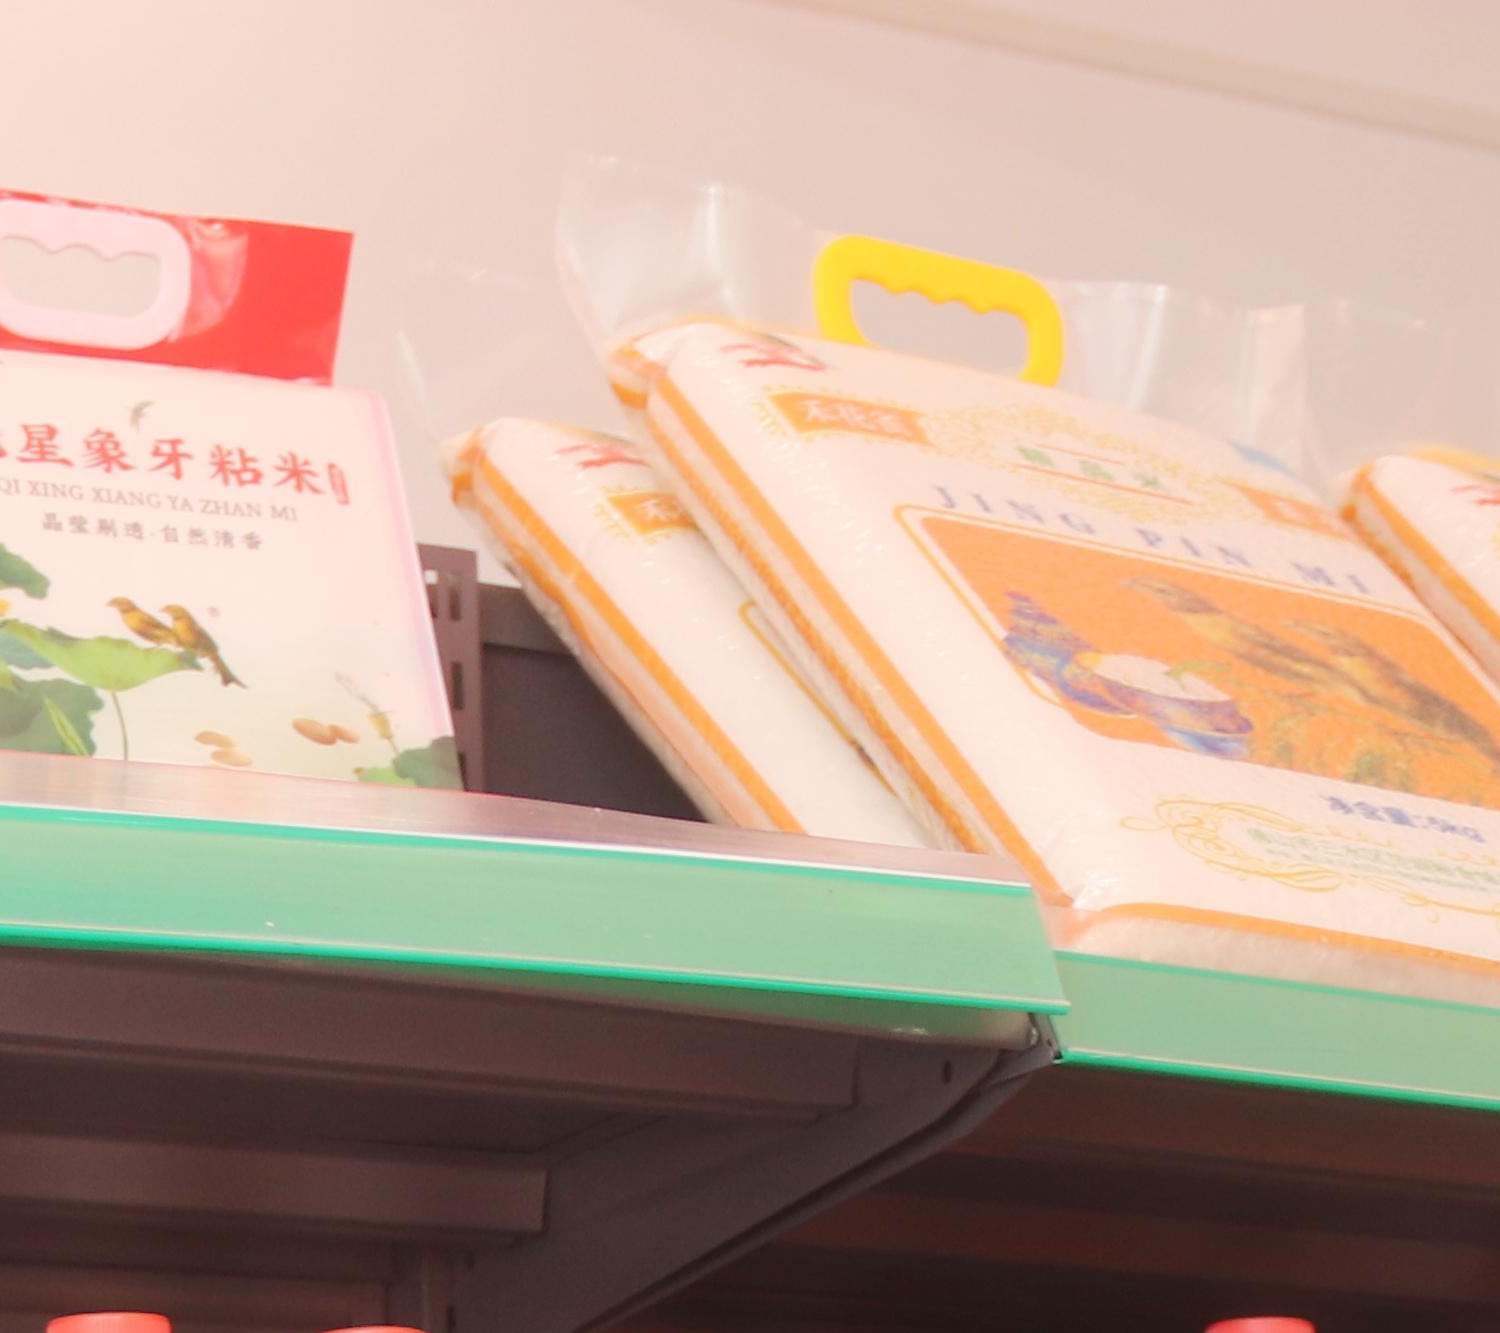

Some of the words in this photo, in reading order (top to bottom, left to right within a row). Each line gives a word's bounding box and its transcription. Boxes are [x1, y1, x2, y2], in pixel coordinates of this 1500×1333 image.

[28, 480, 83, 500] XING
[92, 487, 161, 509] XIANG
[167, 495, 194, 512] YA
[201, 498, 262, 518] ZHAN
[270, 505, 299, 522] MI
[933, 485, 1096, 537] JING
[1137, 525, 1251, 567] PIN
[1290, 557, 1369, 595] MI
